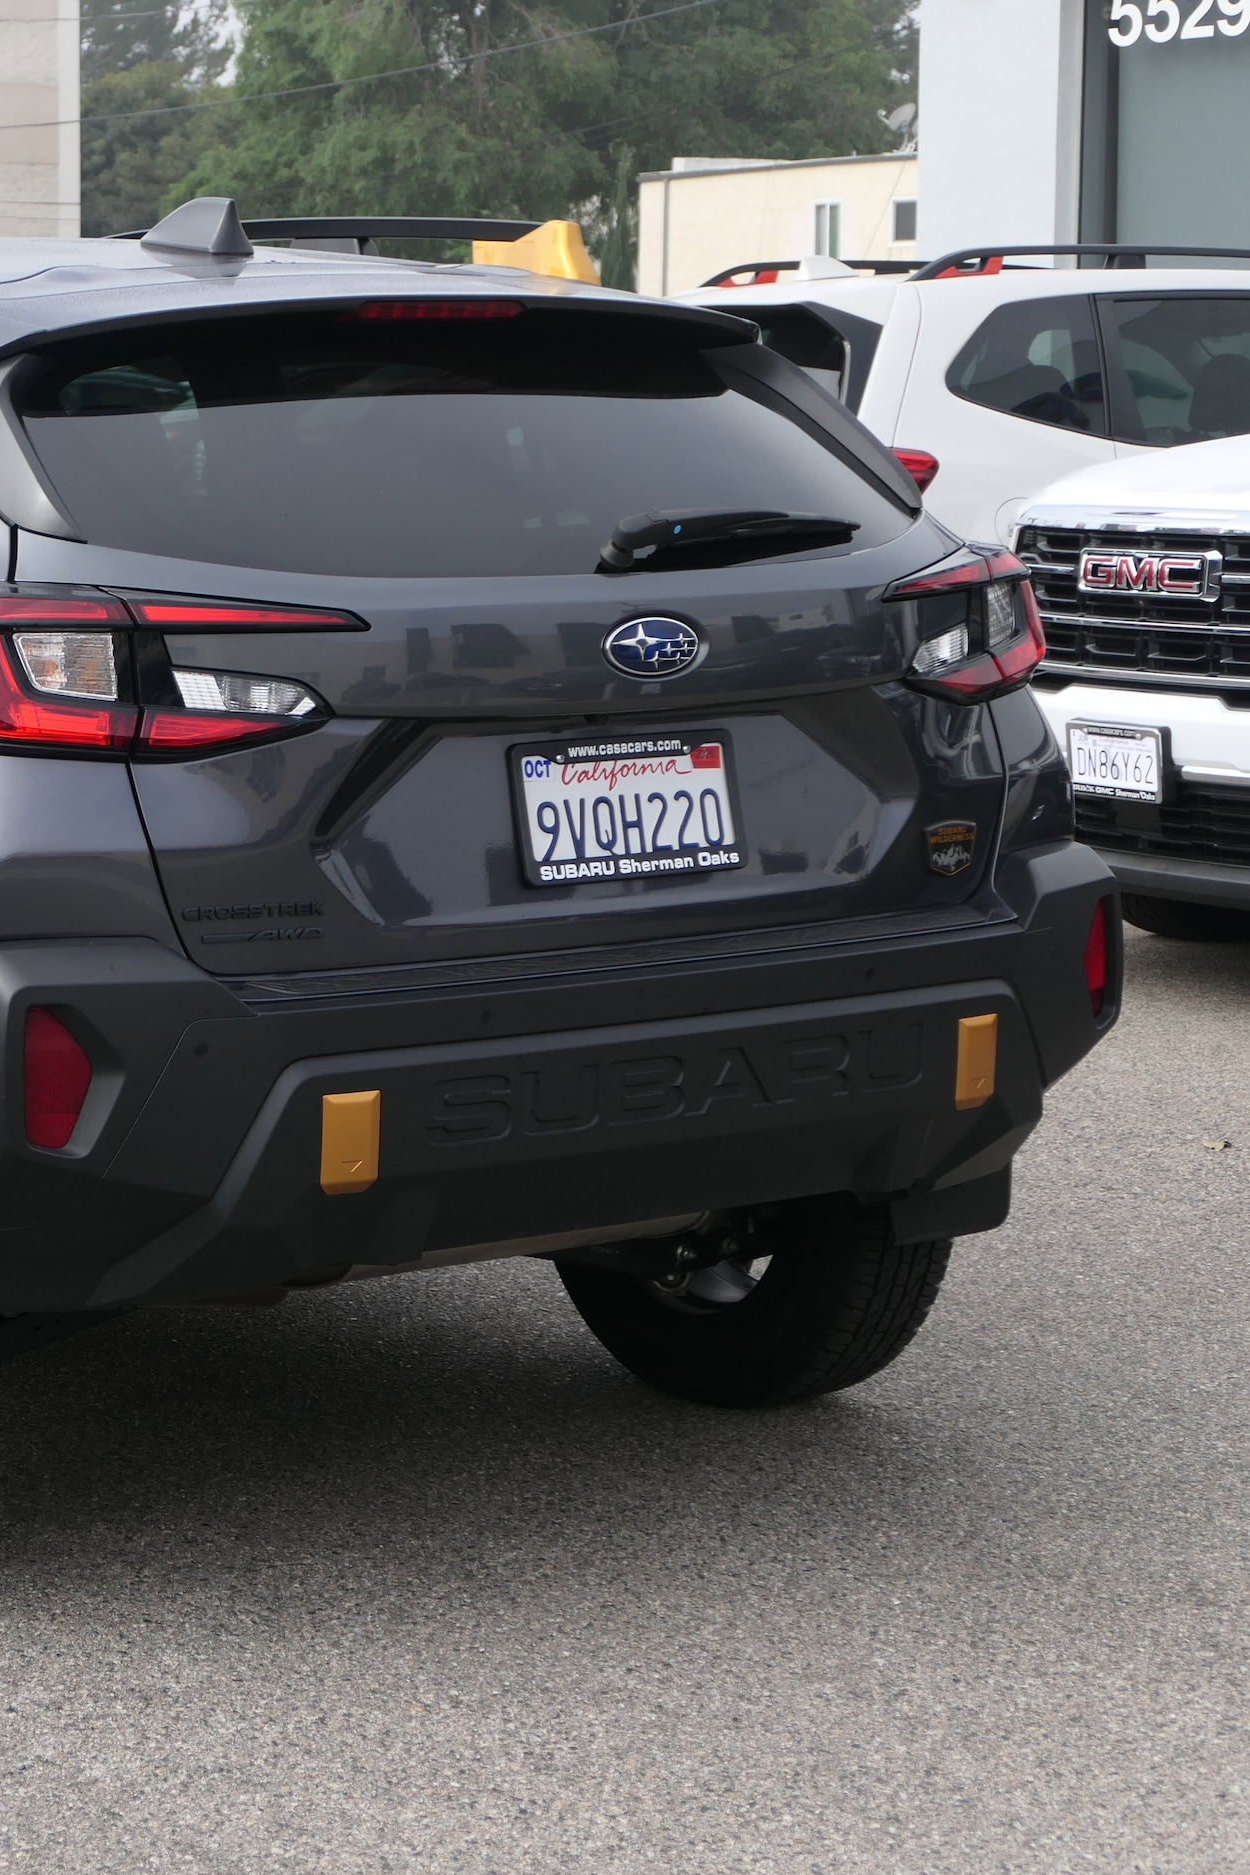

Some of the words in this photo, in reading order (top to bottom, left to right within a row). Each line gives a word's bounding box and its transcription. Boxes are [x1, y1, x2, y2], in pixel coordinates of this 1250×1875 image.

[1107, 0, 1250, 48] 5529
[1083, 554, 1202, 593] GMC
[568, 739, 682, 758] www.casacars.com
[524, 759, 551, 778] OCT
[560, 757, 692, 791] California
[1077, 747, 1154, 785] DN86Y62
[536, 787, 725, 862] 9VQH220
[930, 832, 975, 844] WILDERNESS
[938, 826, 968, 836] SUBARU
[539, 859, 616, 882] SUBARU
[619, 851, 694, 875] Sherman
[698, 850, 740, 867] Oaks
[181, 900, 325, 922] CROSSTREK
[249, 927, 324, 942] AWD
[425, 1022, 926, 1148] SUBARU
